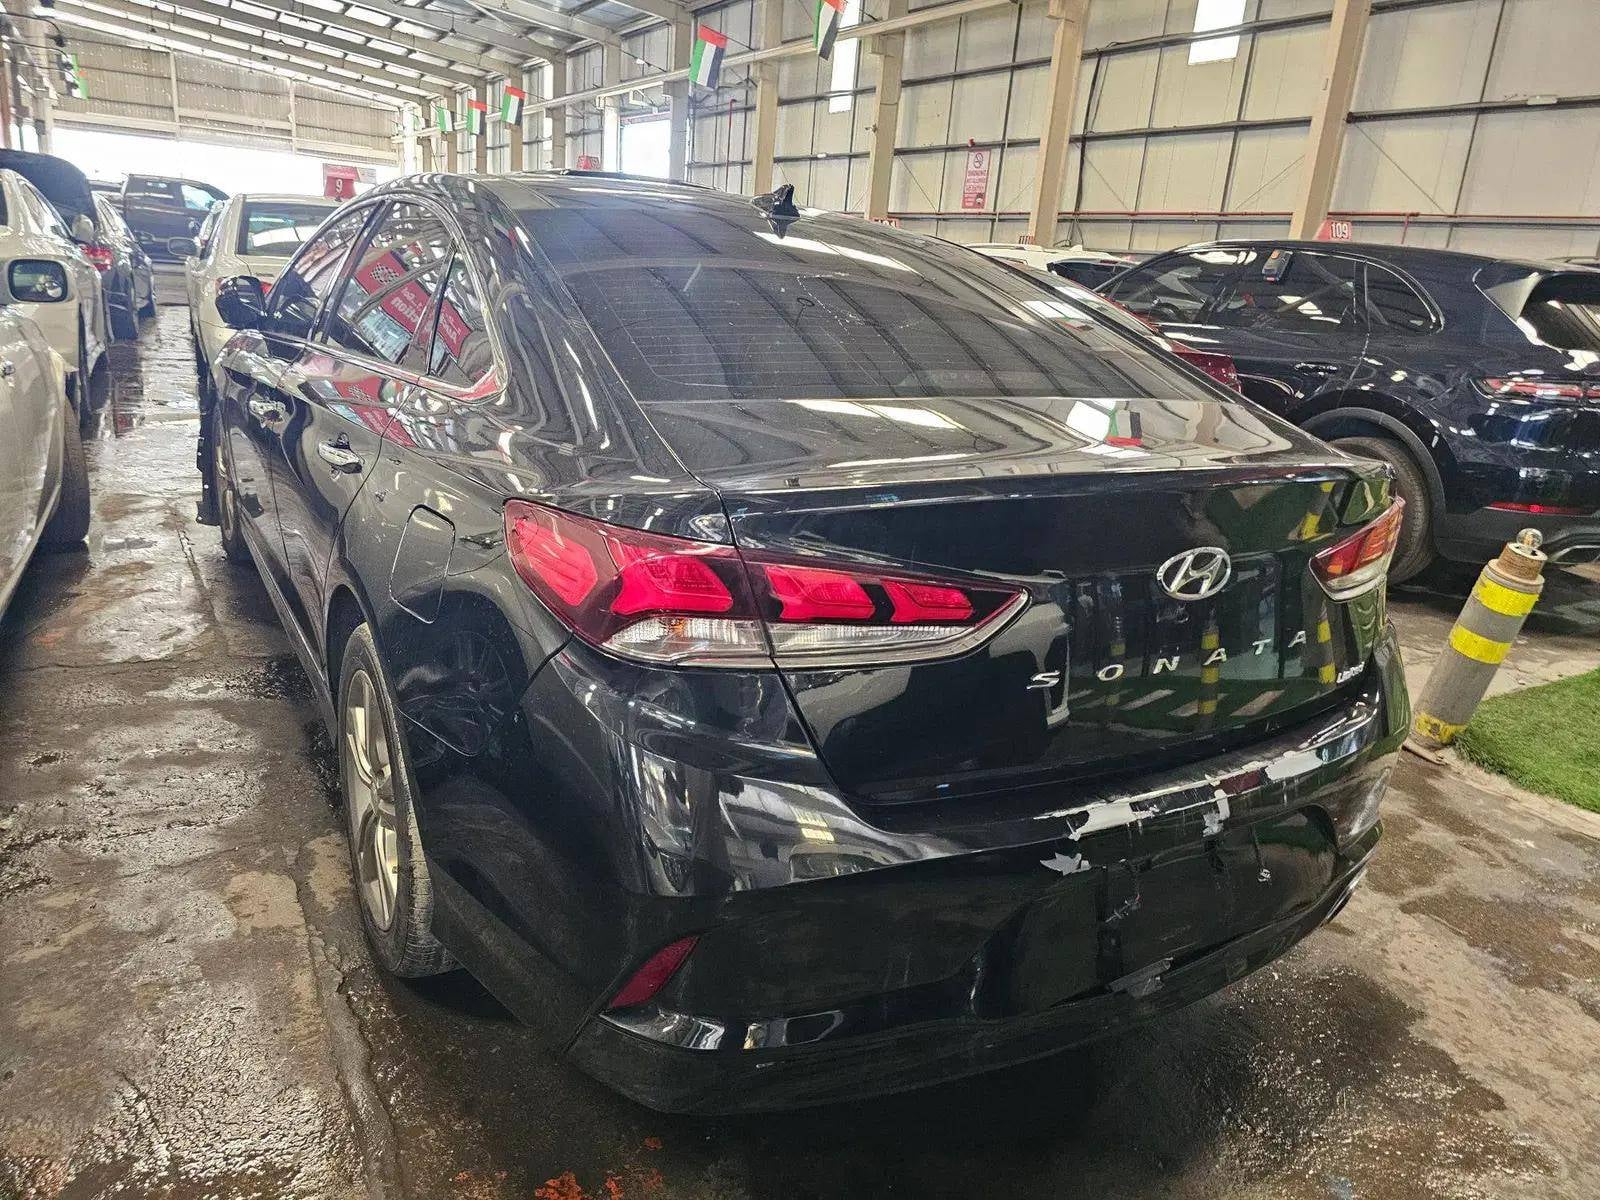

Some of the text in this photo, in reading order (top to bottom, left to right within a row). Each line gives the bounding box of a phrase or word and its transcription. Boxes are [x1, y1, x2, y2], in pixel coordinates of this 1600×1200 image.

[335, 178, 343, 194] 9
[1331, 222, 1349, 239] 109
[1026, 630, 1307, 690] SONATA
